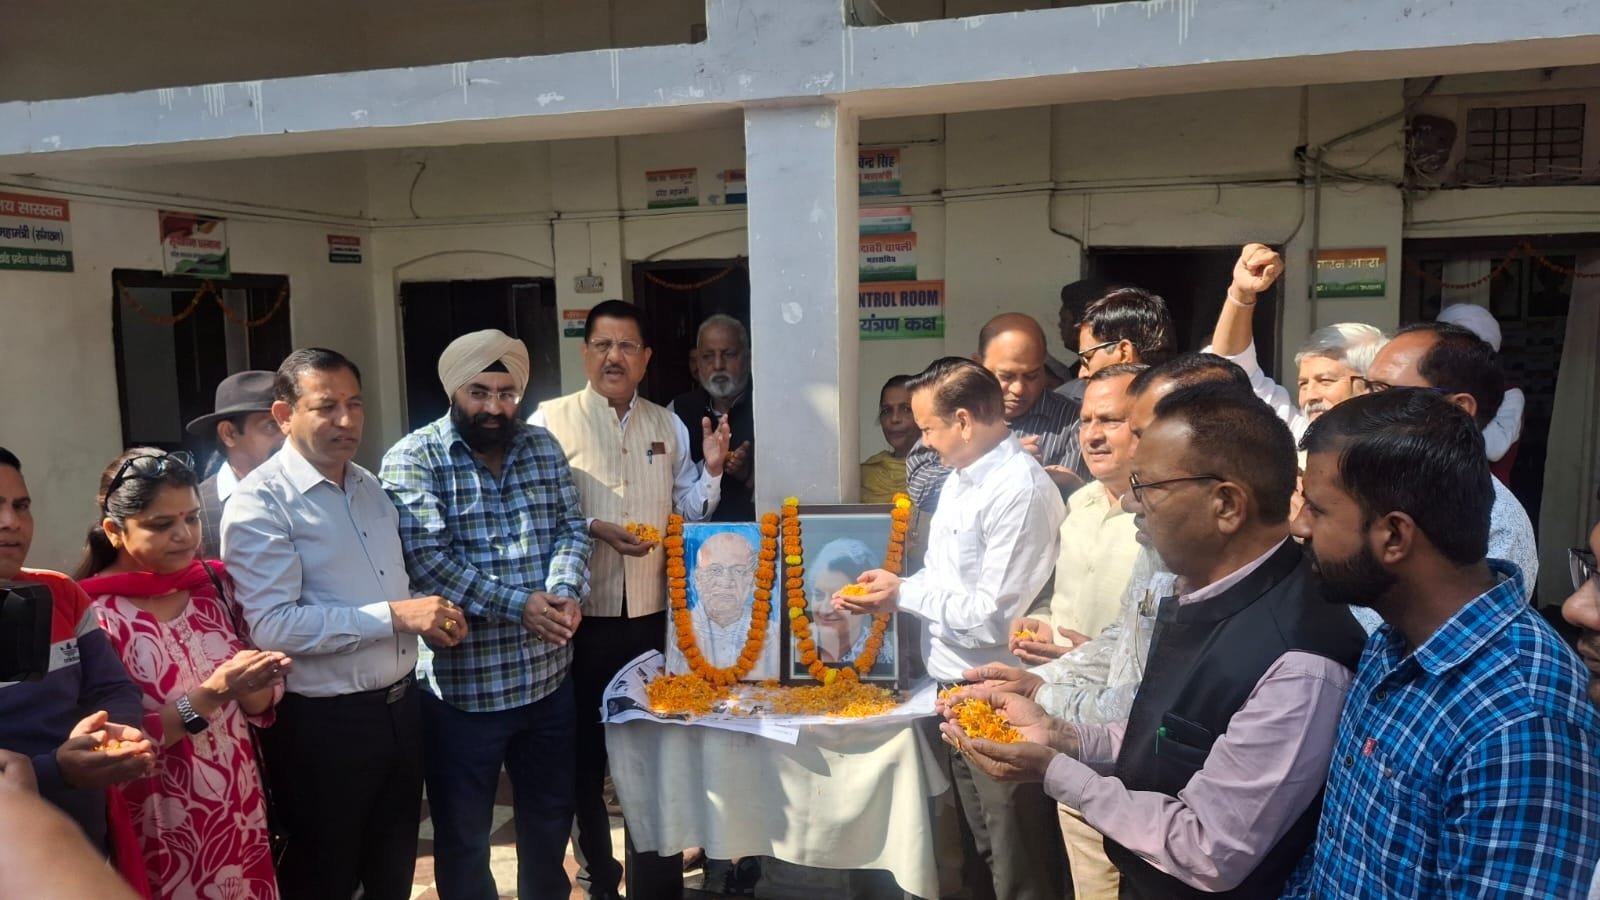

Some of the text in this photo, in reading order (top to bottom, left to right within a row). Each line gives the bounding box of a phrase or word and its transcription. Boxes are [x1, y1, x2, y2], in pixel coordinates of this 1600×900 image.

[18, 201, 64, 217] सारस्वत
[900, 290, 938, 307] ROOM
[904, 316, 937, 332] कक्ष
